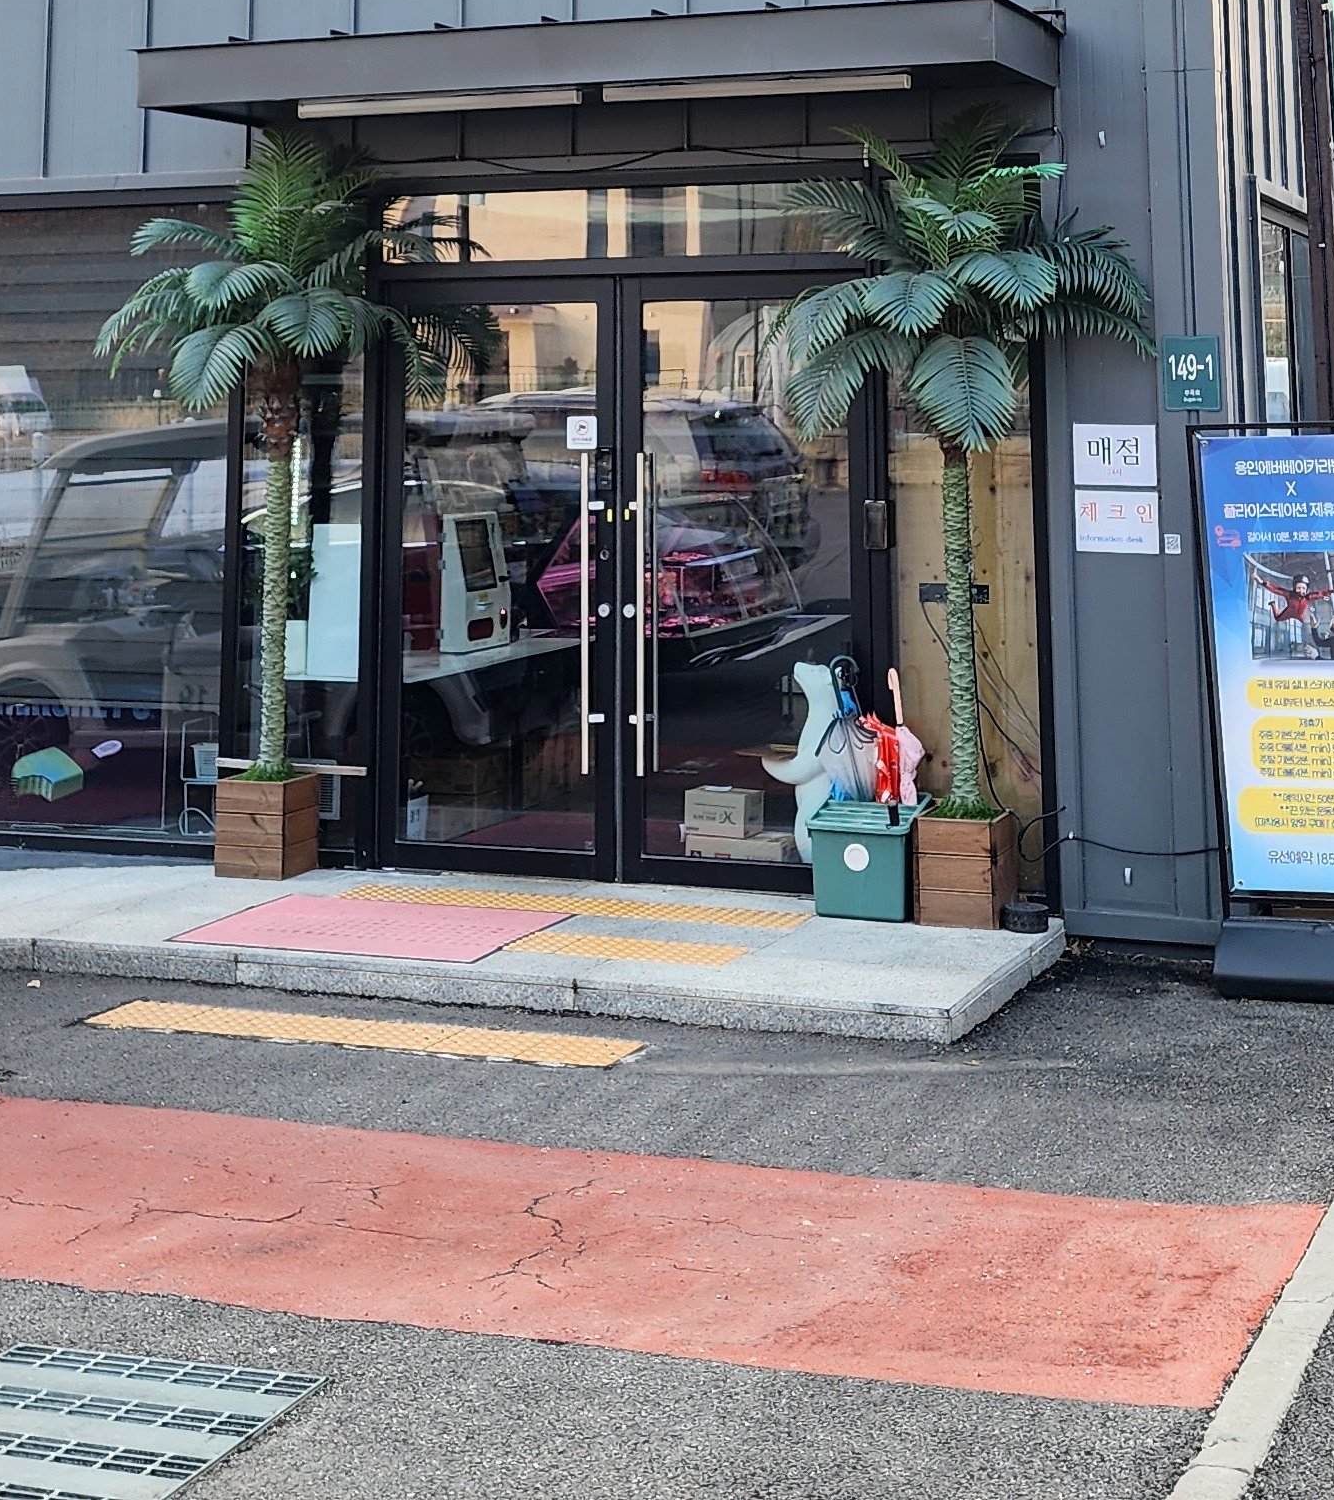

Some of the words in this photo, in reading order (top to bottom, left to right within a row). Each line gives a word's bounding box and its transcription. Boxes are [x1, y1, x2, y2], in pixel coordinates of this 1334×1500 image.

[1168, 353, 1213, 381] 149-1
[1087, 436, 1140, 466] 매점
[1224, 503, 1307, 519] 플라이스테이션
[1310, 502, 1334, 517] 제휴
[1079, 534, 1123, 543] information
[1126, 535, 1144, 544] desk
[1247, 531, 1272, 543] 걸어서
[1292, 530, 1309, 542] 차로
[1310, 531, 1324, 542] 3분
[1268, 850, 1313, 865] 유선예약
